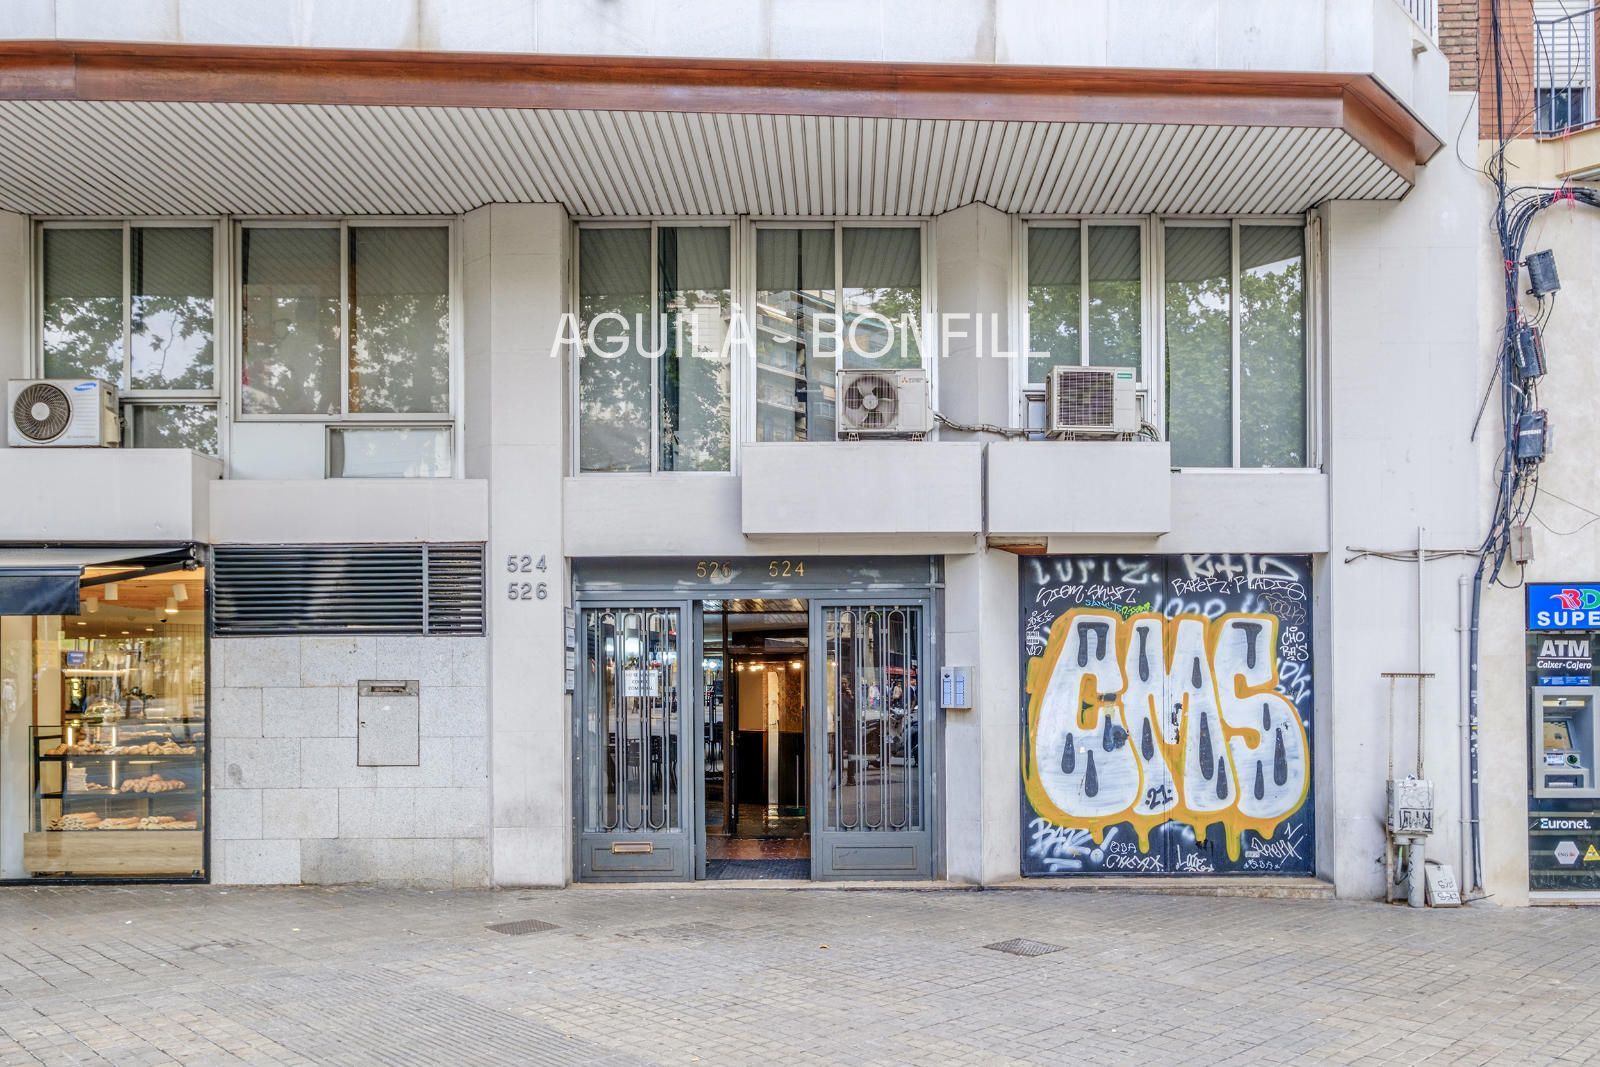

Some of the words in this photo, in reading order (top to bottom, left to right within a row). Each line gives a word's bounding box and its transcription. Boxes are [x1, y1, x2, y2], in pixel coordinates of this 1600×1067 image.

[507, 553, 547, 573] 524
[695, 561, 732, 578] 526
[768, 560, 805, 577] 524
[507, 581, 548, 600] 526
[1537, 611, 1600, 627] SUPE
[1540, 639, 1590, 657] ATM
